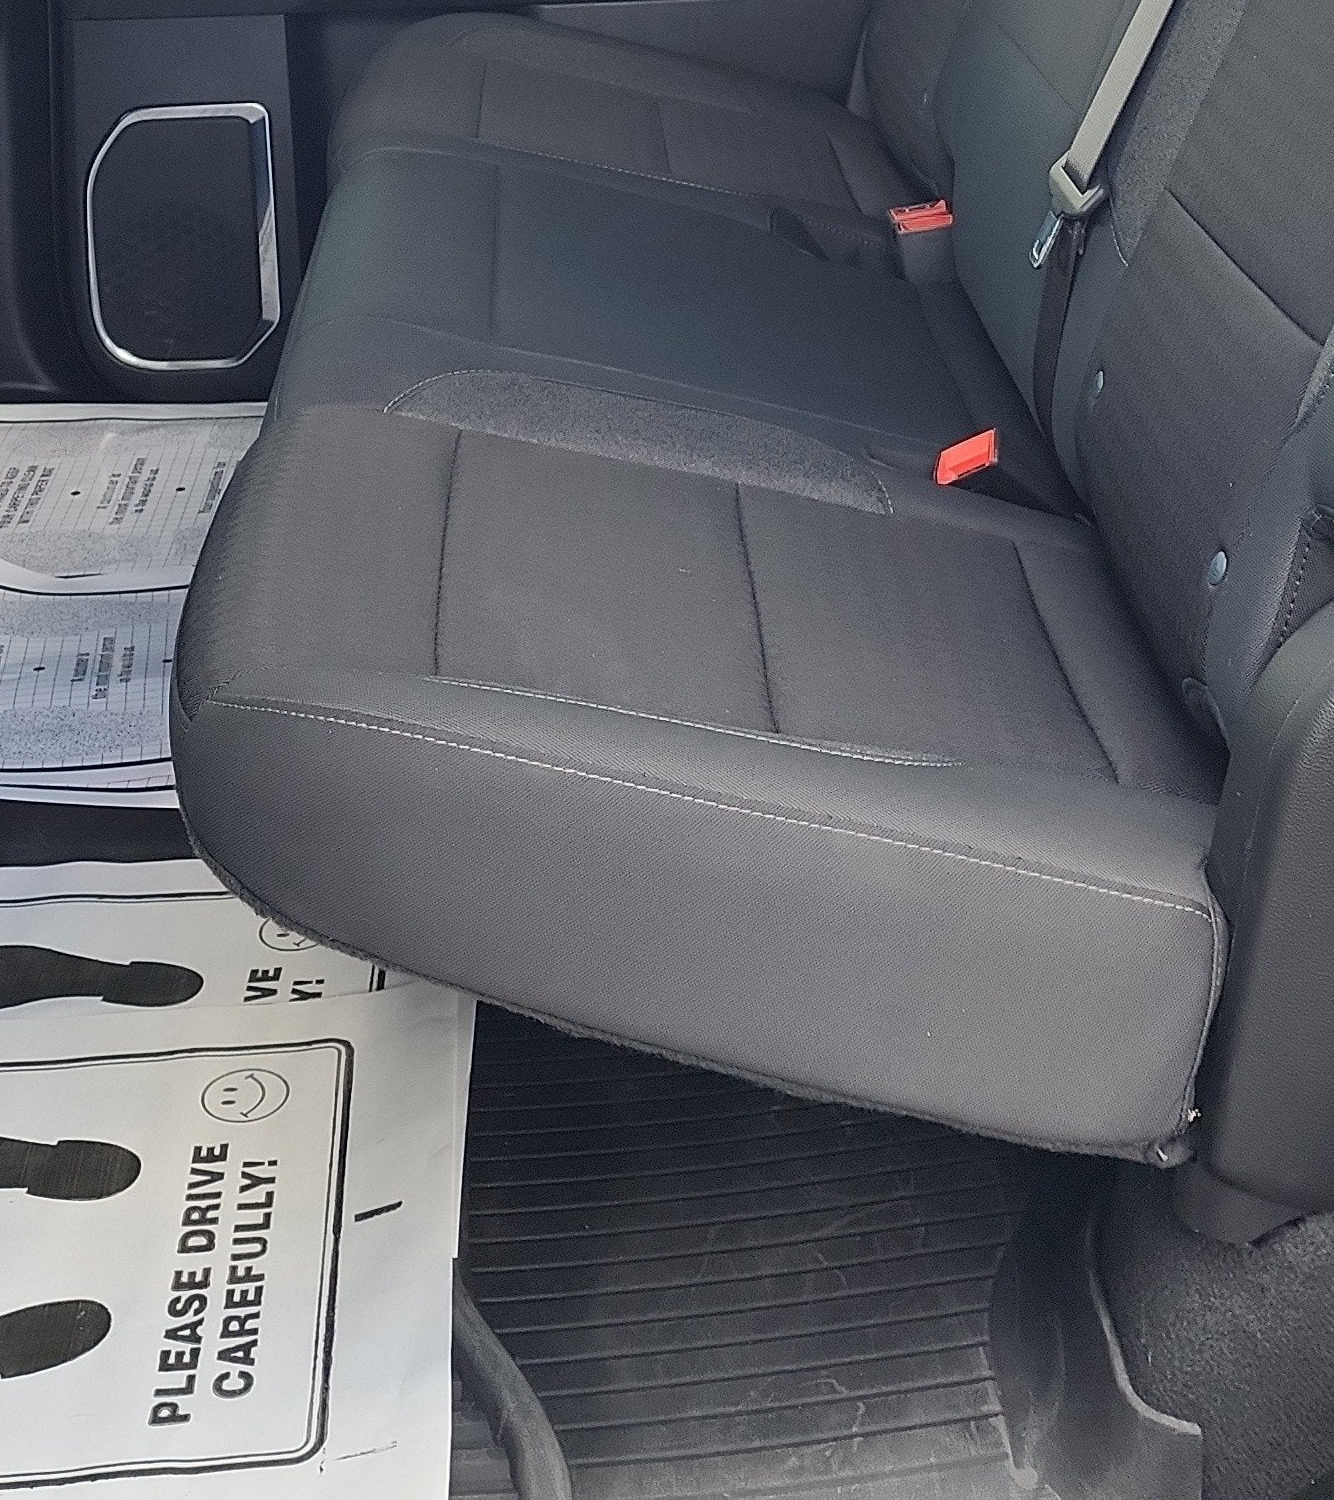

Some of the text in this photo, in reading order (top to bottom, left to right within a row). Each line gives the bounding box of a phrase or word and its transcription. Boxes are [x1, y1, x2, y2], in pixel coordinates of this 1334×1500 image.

[148, 1143, 229, 1426] PLEASE DRIVE
[212, 1159, 278, 1399] CAREFULLY!
